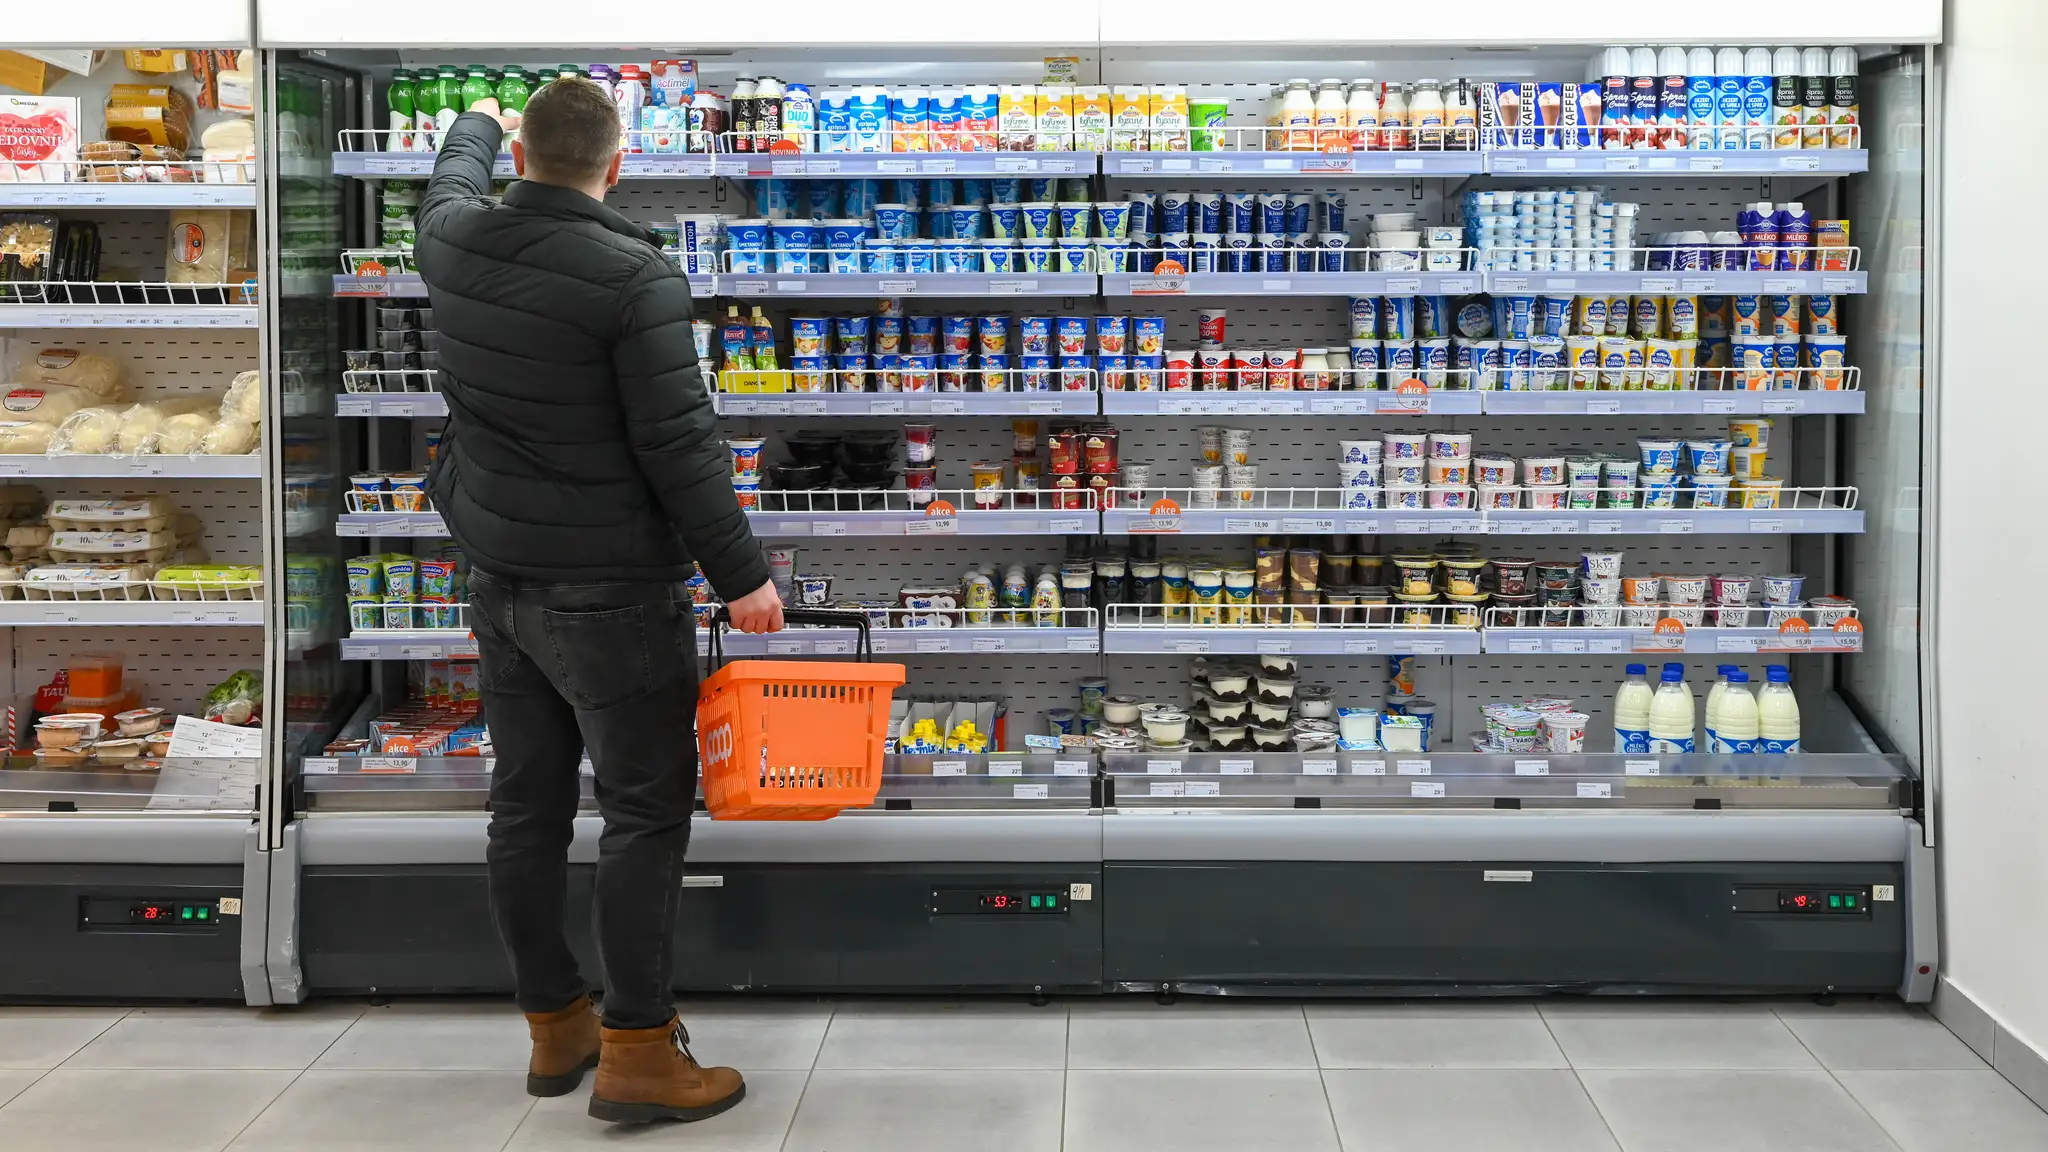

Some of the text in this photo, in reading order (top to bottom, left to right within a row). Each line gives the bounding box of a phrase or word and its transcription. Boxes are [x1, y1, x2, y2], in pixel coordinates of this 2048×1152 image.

[657, 78, 690, 89] Actimel
[1602, 91, 1629, 103] Spray
[1630, 91, 1656, 103] Spray
[1661, 91, 1687, 103] Spray
[788, 111, 808, 122] DUO
[1522, 83, 1532, 145] EISKAFFEE
[0, 134, 64, 147] EDOVNÍK
[770, 147, 800, 157] NOVINKA
[1327, 145, 1348, 154] akce
[385, 206, 408, 214] ACTIVIA
[1754, 232, 1776, 240] MLÉKO
[1786, 232, 1807, 240] MLÉKO
[361, 268, 381, 277] akce
[1159, 266, 1180, 275] akce
[1402, 385, 1422, 394] akce
[930, 507, 951, 516] akce
[1155, 505, 1176, 514] akce
[935, 520, 950, 528] 13,90
[1589, 559, 1614, 571] Skyr
[805, 583, 825, 593] Monte
[1582, 584, 1604, 596] Skyr
[1723, 583, 1747, 595] Skyr
[1763, 582, 1787, 593] Skyr
[912, 600, 931, 609] Monte
[1659, 625, 1680, 634] akce
[1784, 625, 1805, 634] akce
[1838, 624, 1858, 633] akce
[1666, 638, 1683, 646] 15,90
[1750, 638, 1767, 646] 15,90
[1795, 638, 1812, 646] 15,90
[1840, 638, 1857, 646] 15,90
[388, 744, 409, 753] akce
[706, 722, 733, 768] coop
